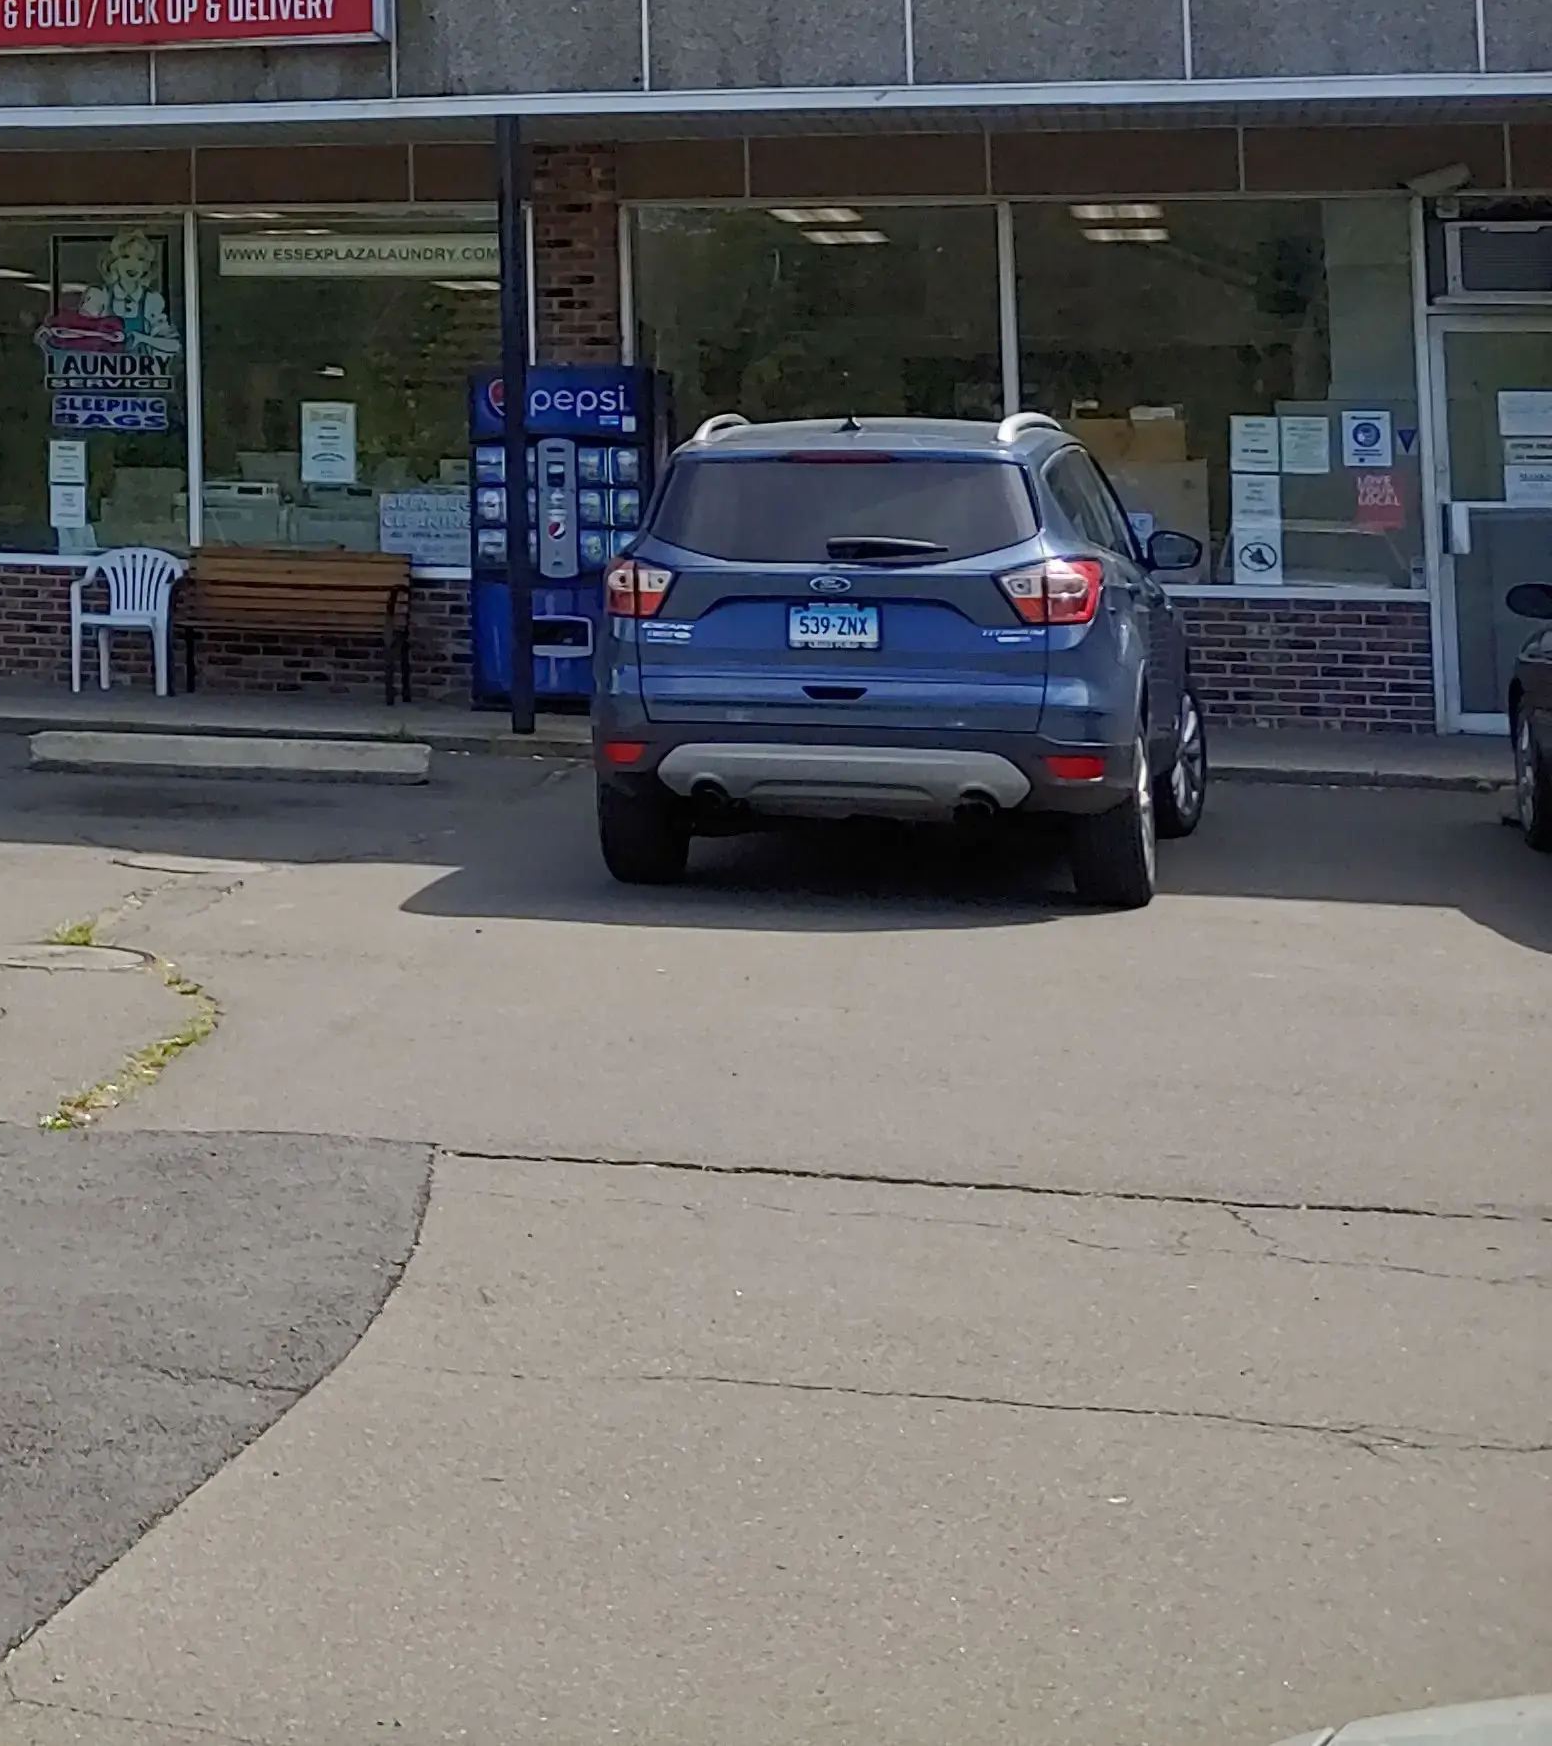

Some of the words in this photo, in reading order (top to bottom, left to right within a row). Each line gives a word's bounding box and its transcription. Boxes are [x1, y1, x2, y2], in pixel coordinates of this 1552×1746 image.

[47, 355, 171, 376] LAUNDRY
[50, 378, 169, 389] SERVICE
[55, 397, 166, 413] SLEEPING
[529, 385, 626, 418] pepsi
[55, 413, 167, 427] BAGS
[1357, 475, 1391, 487] LOVE
[1358, 486, 1395, 497] YOUR
[1357, 495, 1401, 506] LOCAL
